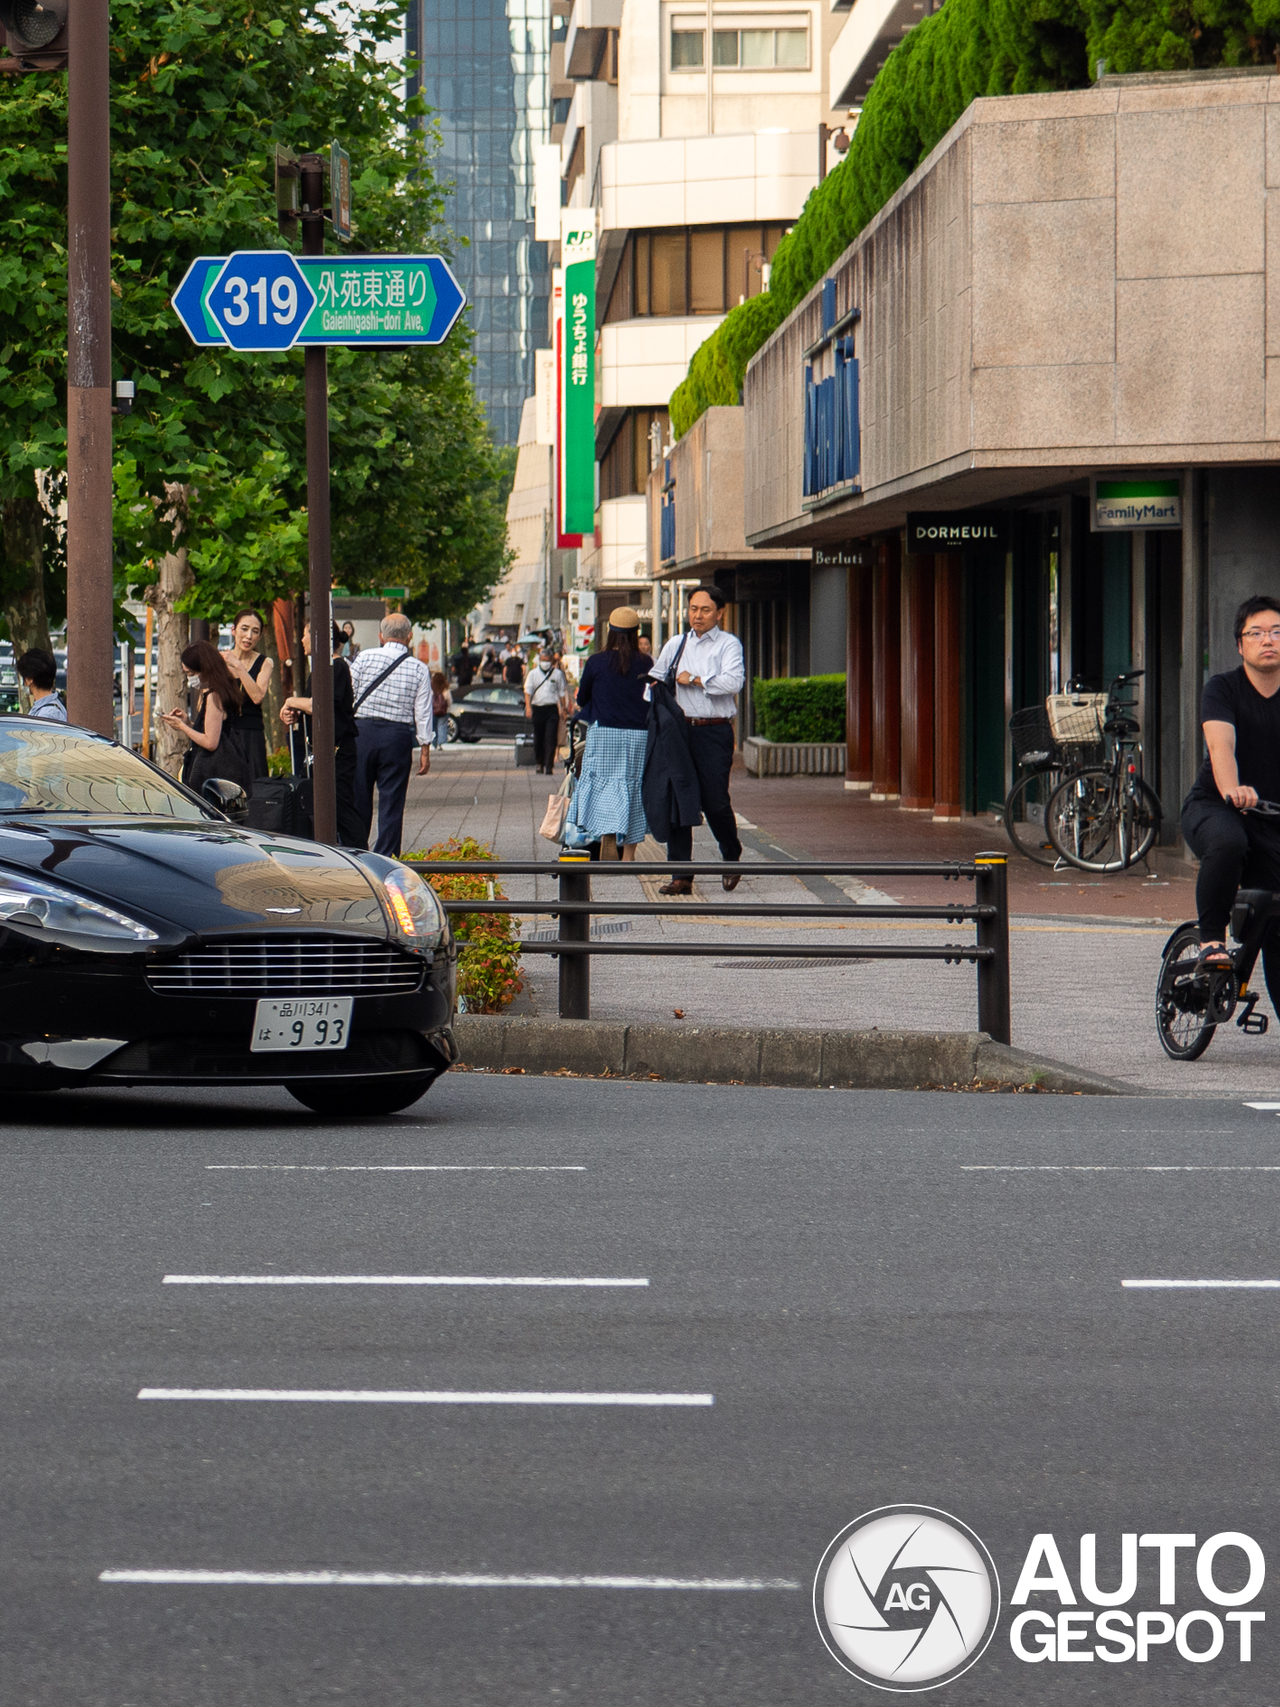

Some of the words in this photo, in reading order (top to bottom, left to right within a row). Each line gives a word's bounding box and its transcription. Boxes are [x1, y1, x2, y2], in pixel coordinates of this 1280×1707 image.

[318, 270, 427, 308] 外苑東通り
[223, 276, 298, 326] 319
[322, 310, 401, 334] Gaienhigashi-dori
[404, 312, 424, 332] Ave.
[572, 293, 588, 385] ゆうちょ銀行
[1098, 504, 1176, 521] FamilyMart
[916, 526, 998, 538] DORMEUIL
[815, 551, 863, 564] Berluti
[259, 1029, 272, 1040] は
